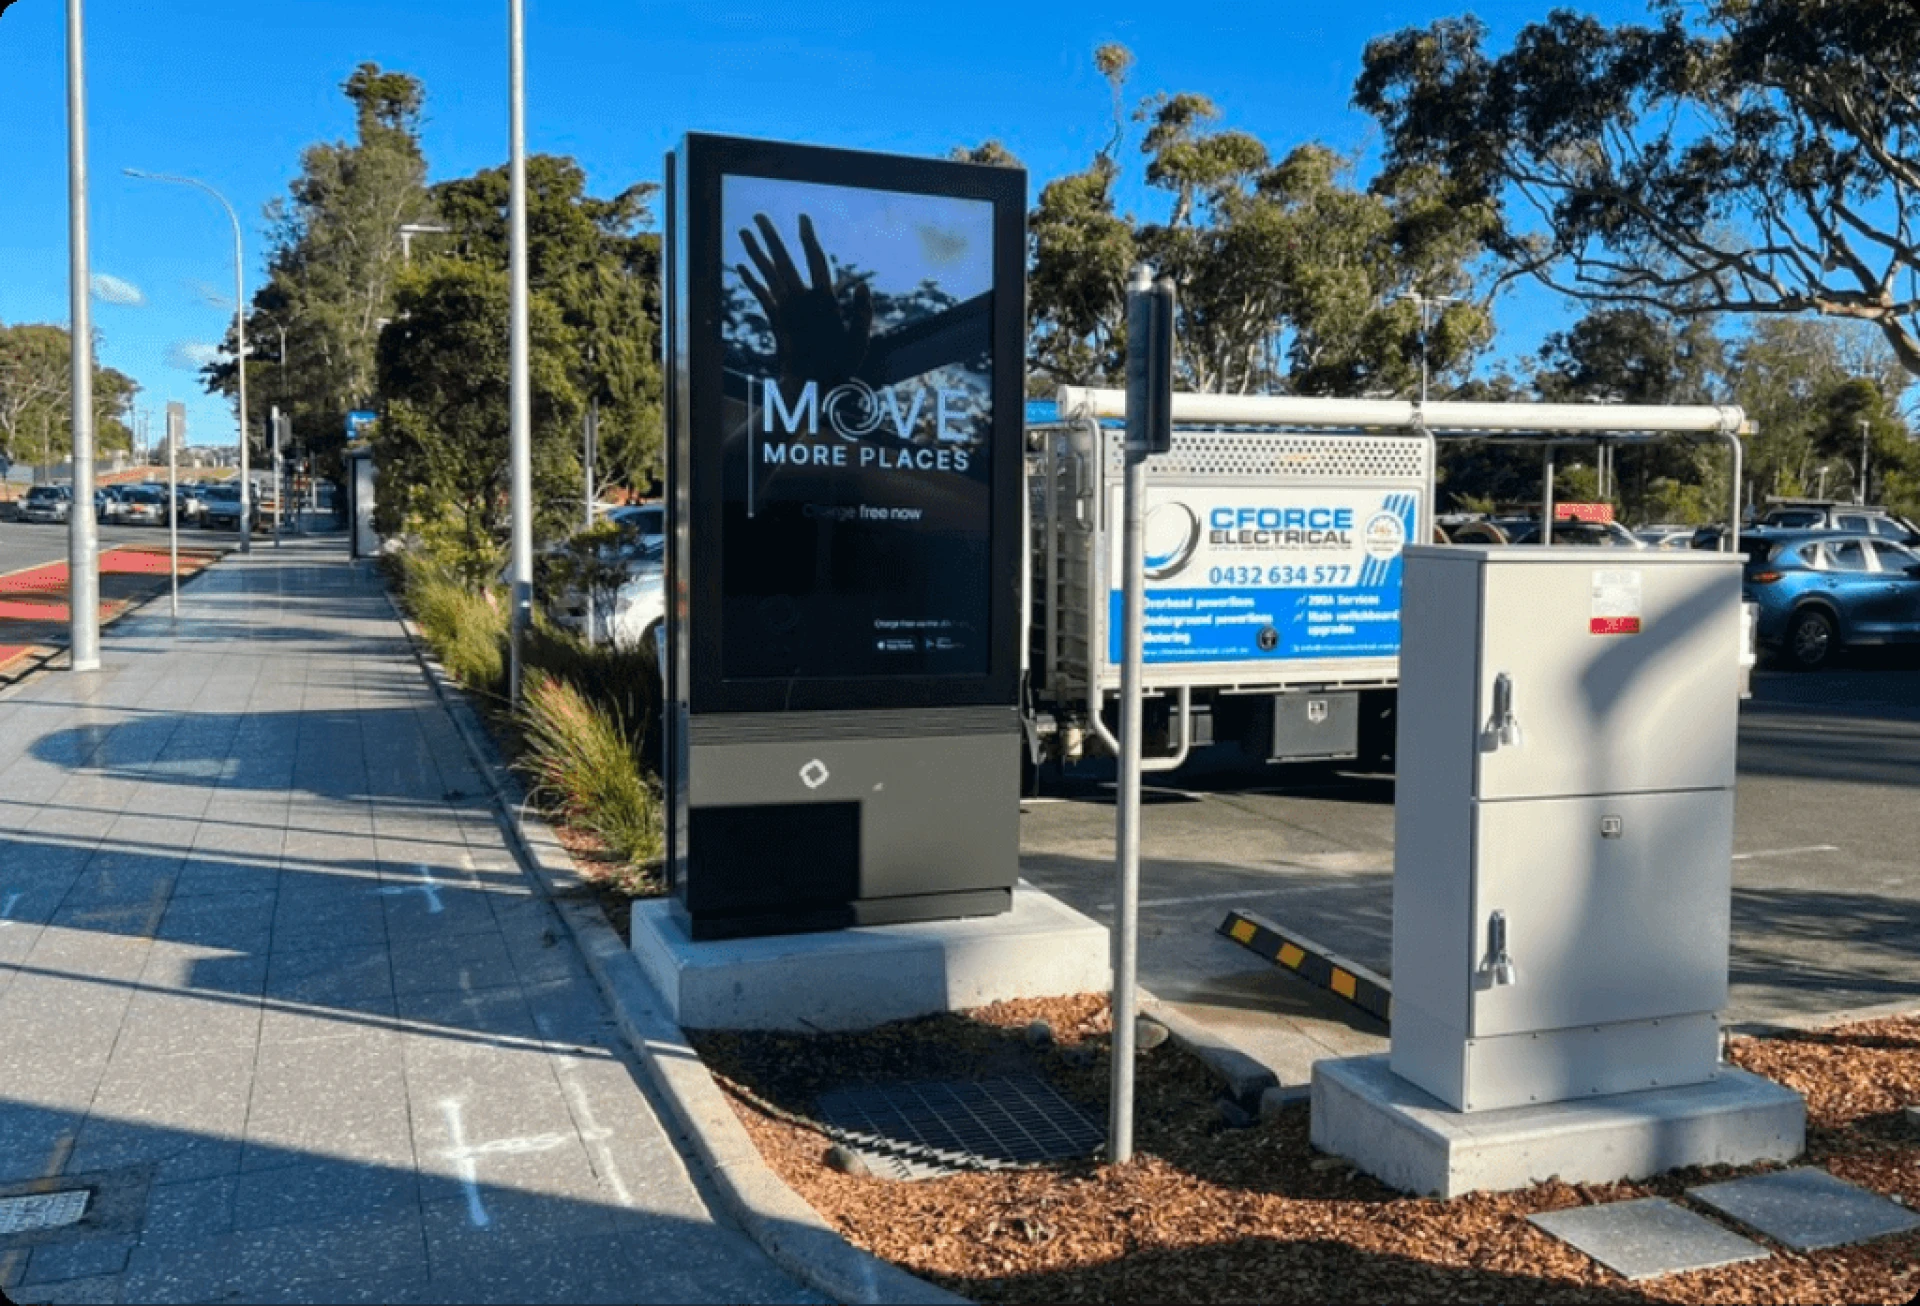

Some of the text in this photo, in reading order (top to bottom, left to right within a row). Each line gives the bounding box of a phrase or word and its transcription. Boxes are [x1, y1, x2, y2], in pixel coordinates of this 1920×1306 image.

[764, 377, 970, 442] MOVE
[763, 442, 970, 471] MORE PLACES
[803, 503, 923, 522] Carge free now
[1210, 507, 1353, 529] CFORCE
[1209, 530, 1352, 544] ELECTRICAL
[1208, 564, 1351, 584] 0432 634 577
